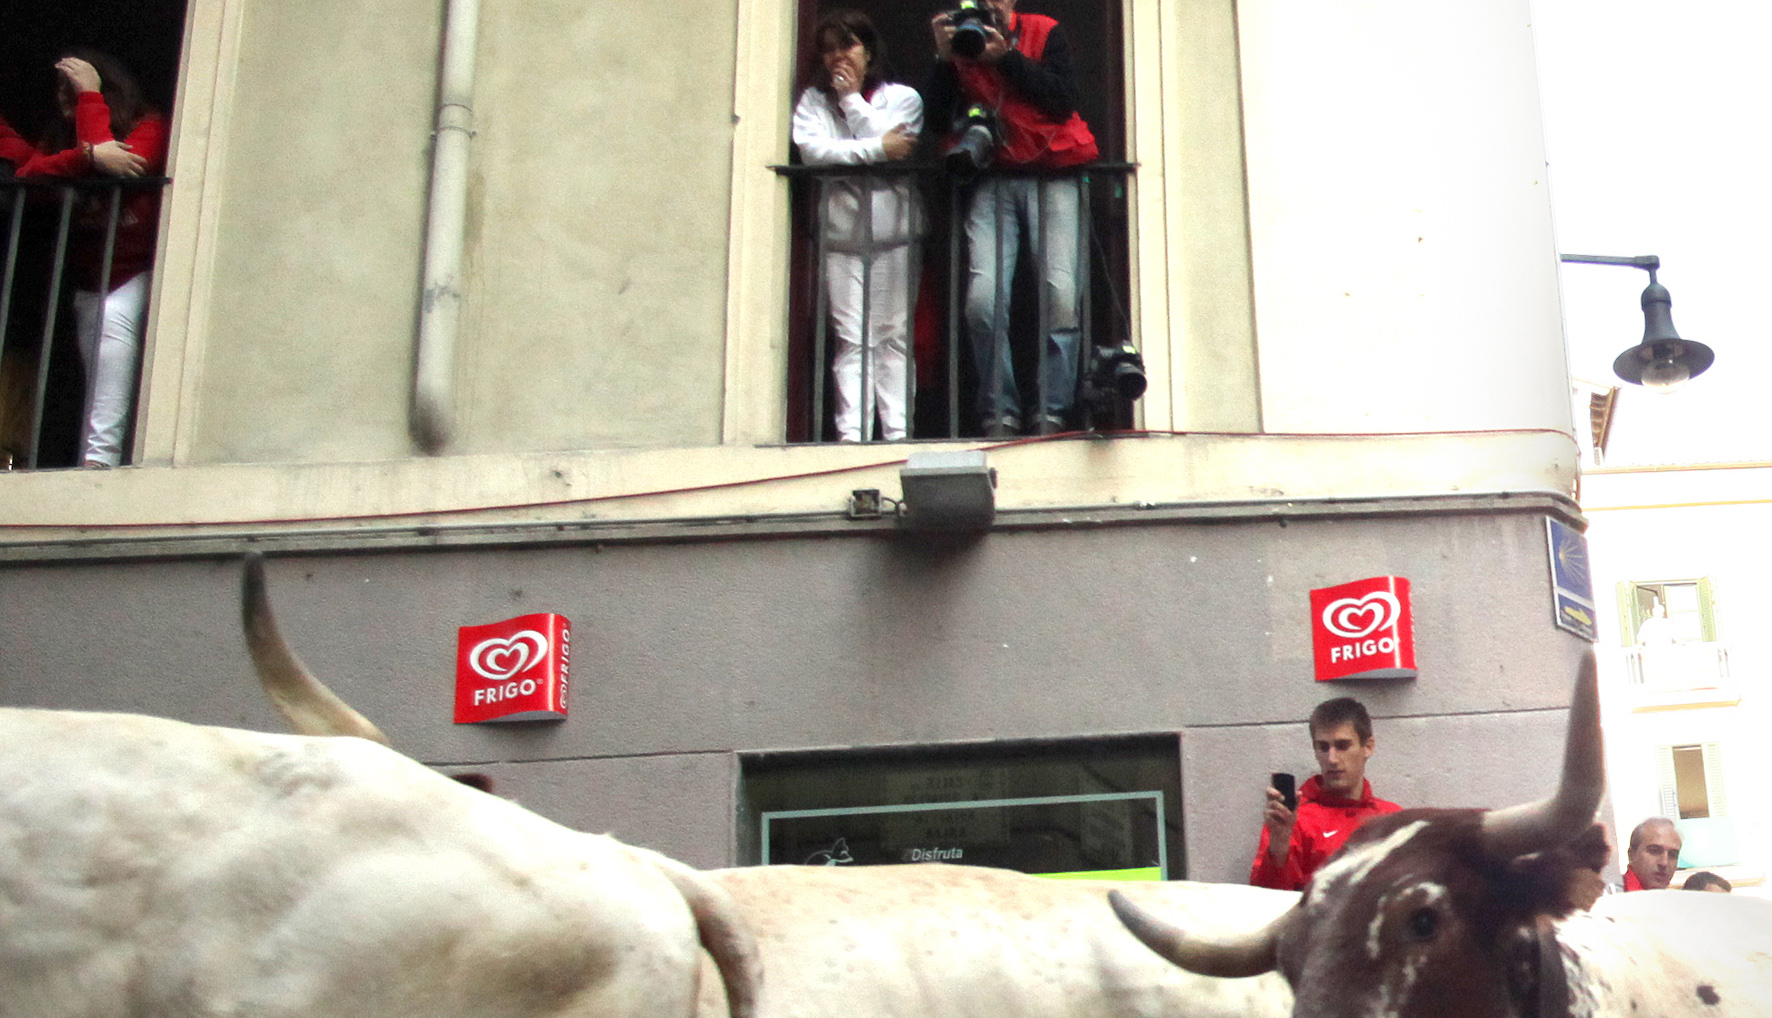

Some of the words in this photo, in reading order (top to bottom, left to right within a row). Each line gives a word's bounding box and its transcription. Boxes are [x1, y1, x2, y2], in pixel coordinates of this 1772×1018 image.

[559, 628, 571, 685] FRIGO
[1330, 637, 1395, 664] FRIGO
[473, 678, 537, 706] FRIGO
[911, 847, 964, 862] Disfruta
